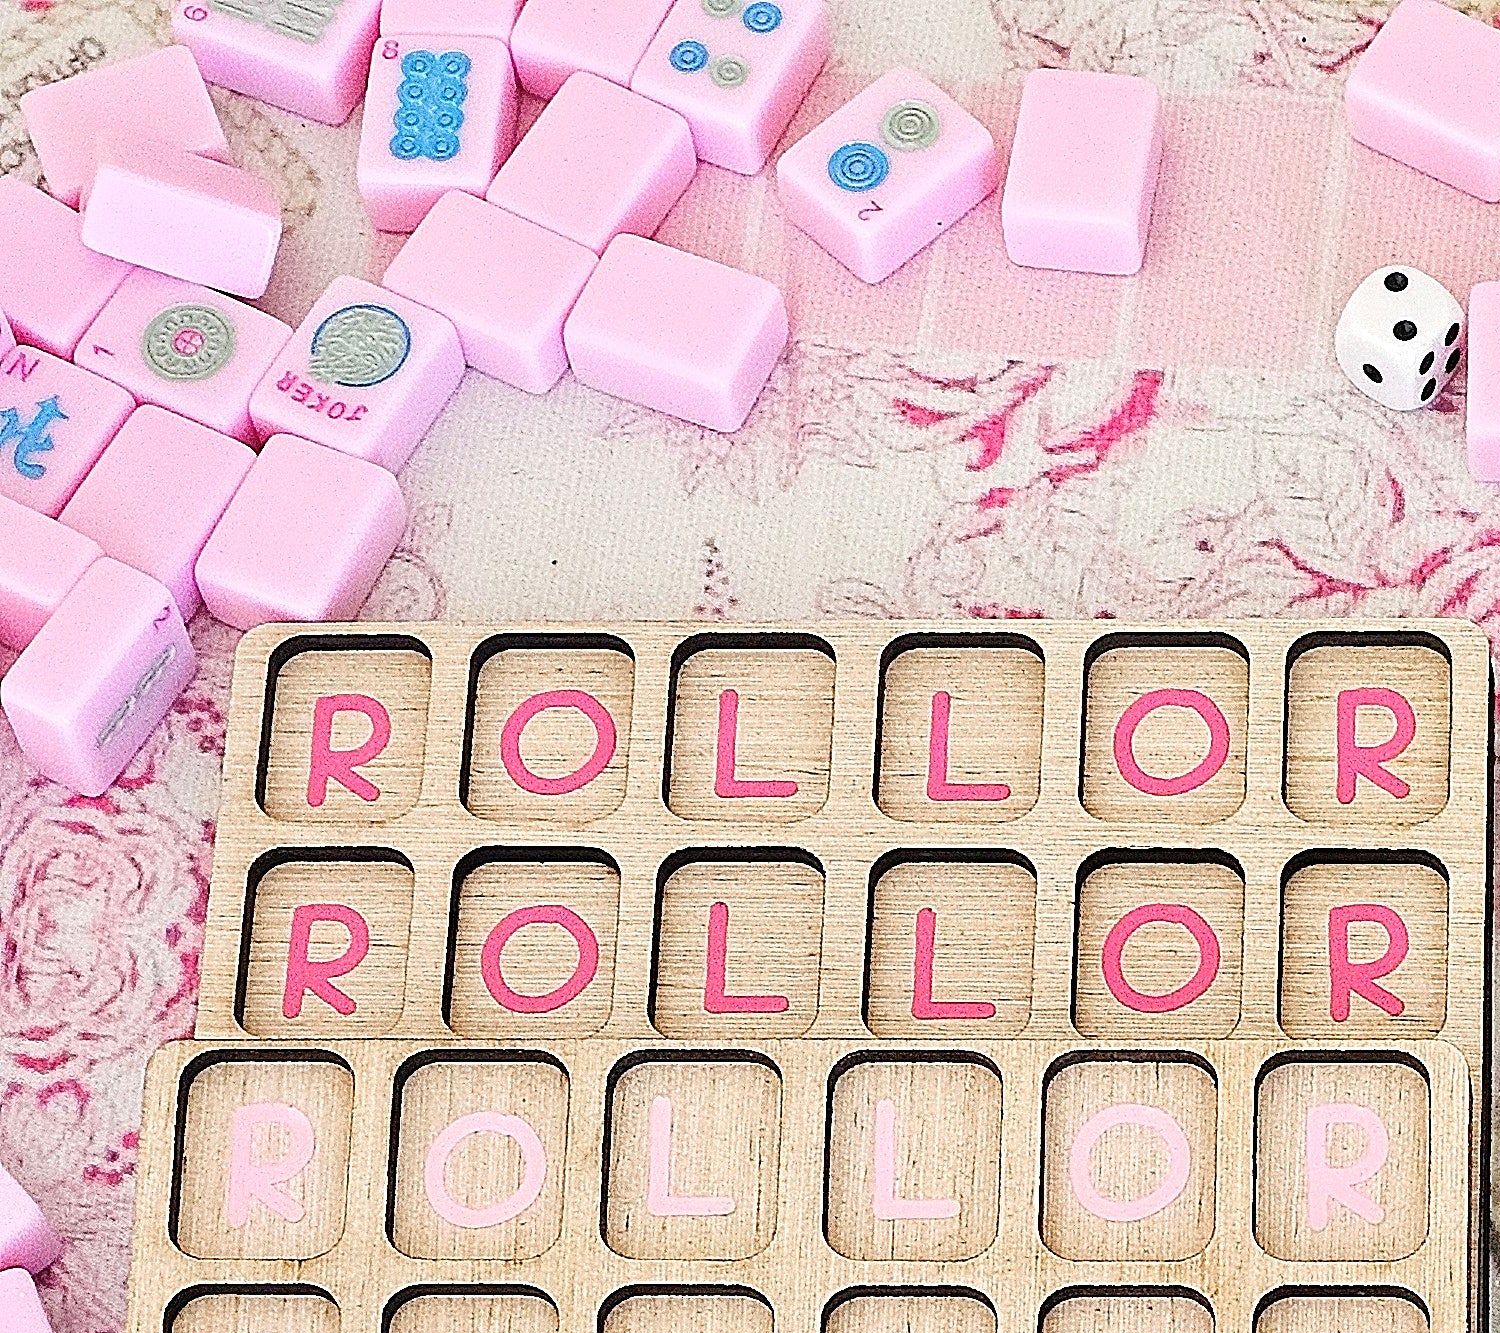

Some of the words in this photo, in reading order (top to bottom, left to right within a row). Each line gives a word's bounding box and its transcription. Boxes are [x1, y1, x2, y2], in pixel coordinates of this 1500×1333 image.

[381, 39, 399, 60] 8
[857, 199, 884, 222] 2
[92, 344, 116, 356] 1
[275, 369, 372, 422] JOKER
